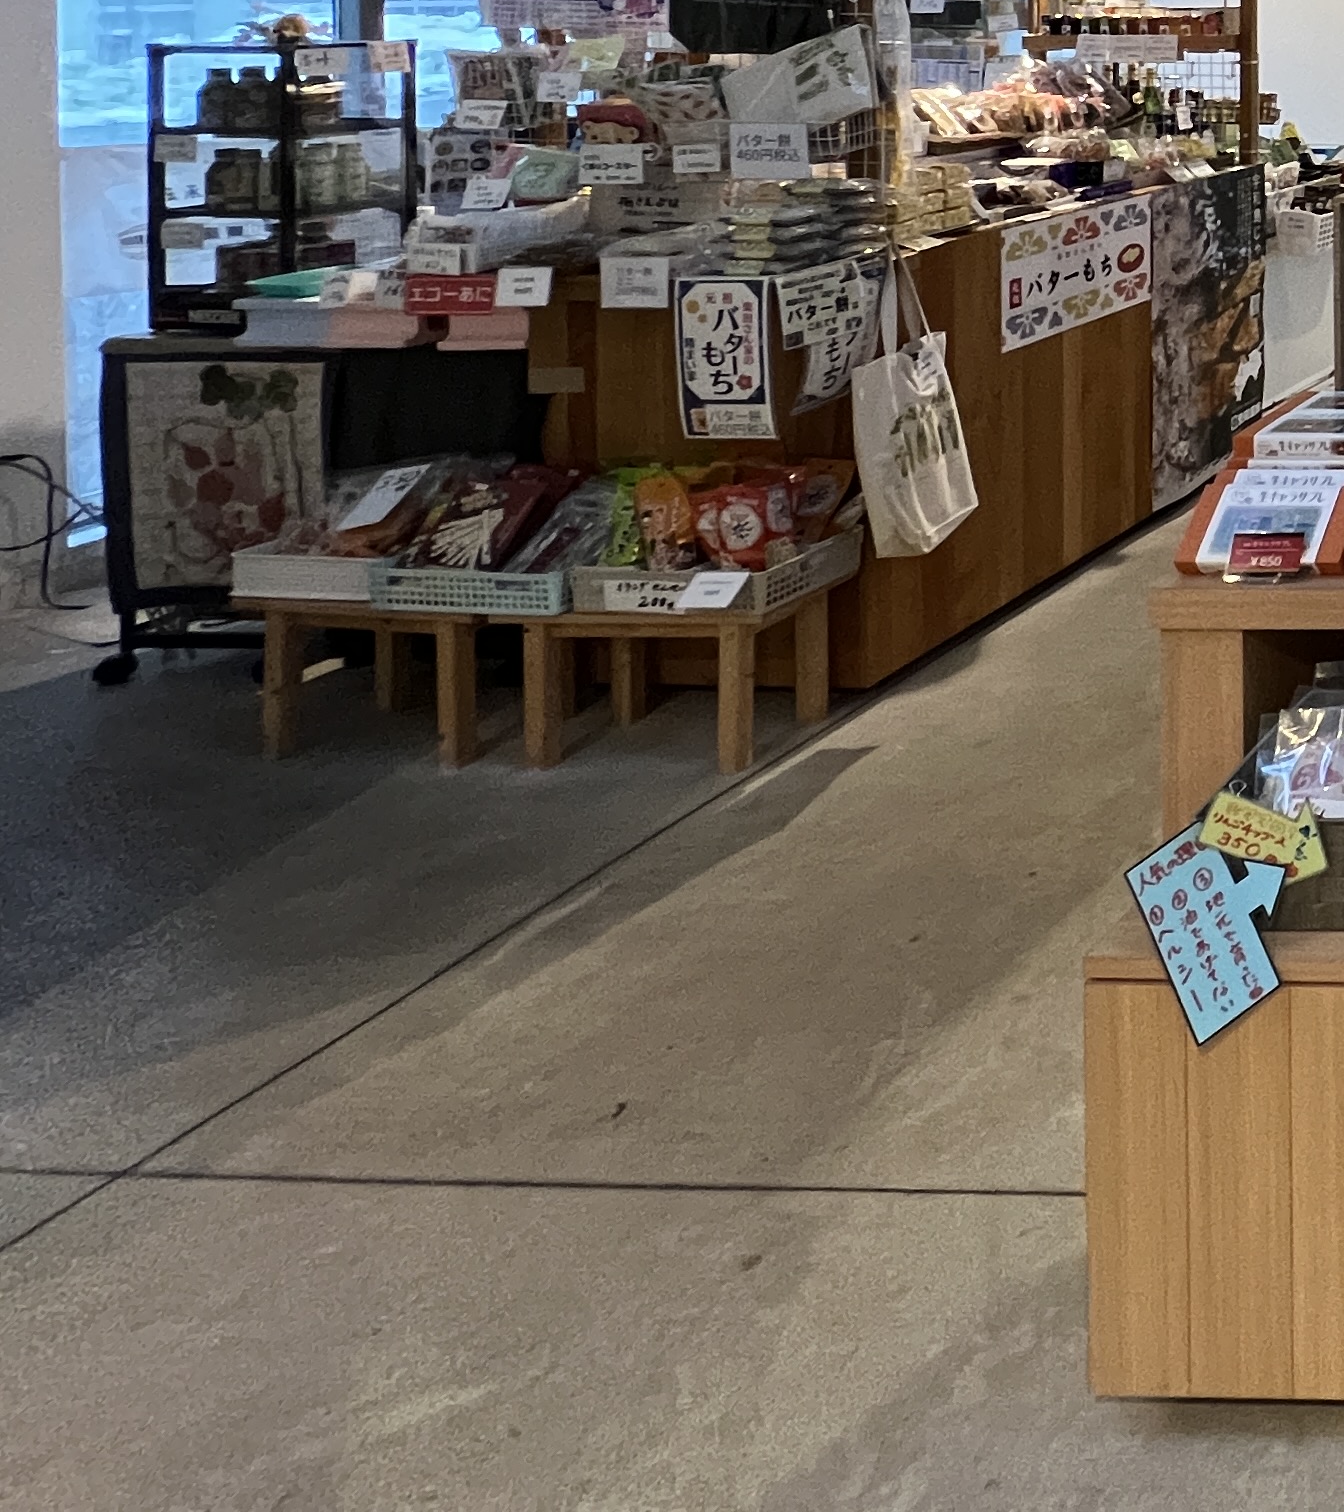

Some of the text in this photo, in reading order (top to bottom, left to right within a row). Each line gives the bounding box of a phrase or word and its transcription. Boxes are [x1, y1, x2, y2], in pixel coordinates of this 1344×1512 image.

[736, 134, 791, 148] バター餅
[736, 149, 800, 163] 460円税込
[1026, 254, 1113, 298] バターもち
[408, 287, 491, 303] エコーあに
[712, 306, 743, 375] バター
[702, 341, 734, 395] もち
[1250, 555, 1283, 567] ¥850
[1217, 831, 1261, 858] 350
[1138, 840, 1207, 897] 人気の理
